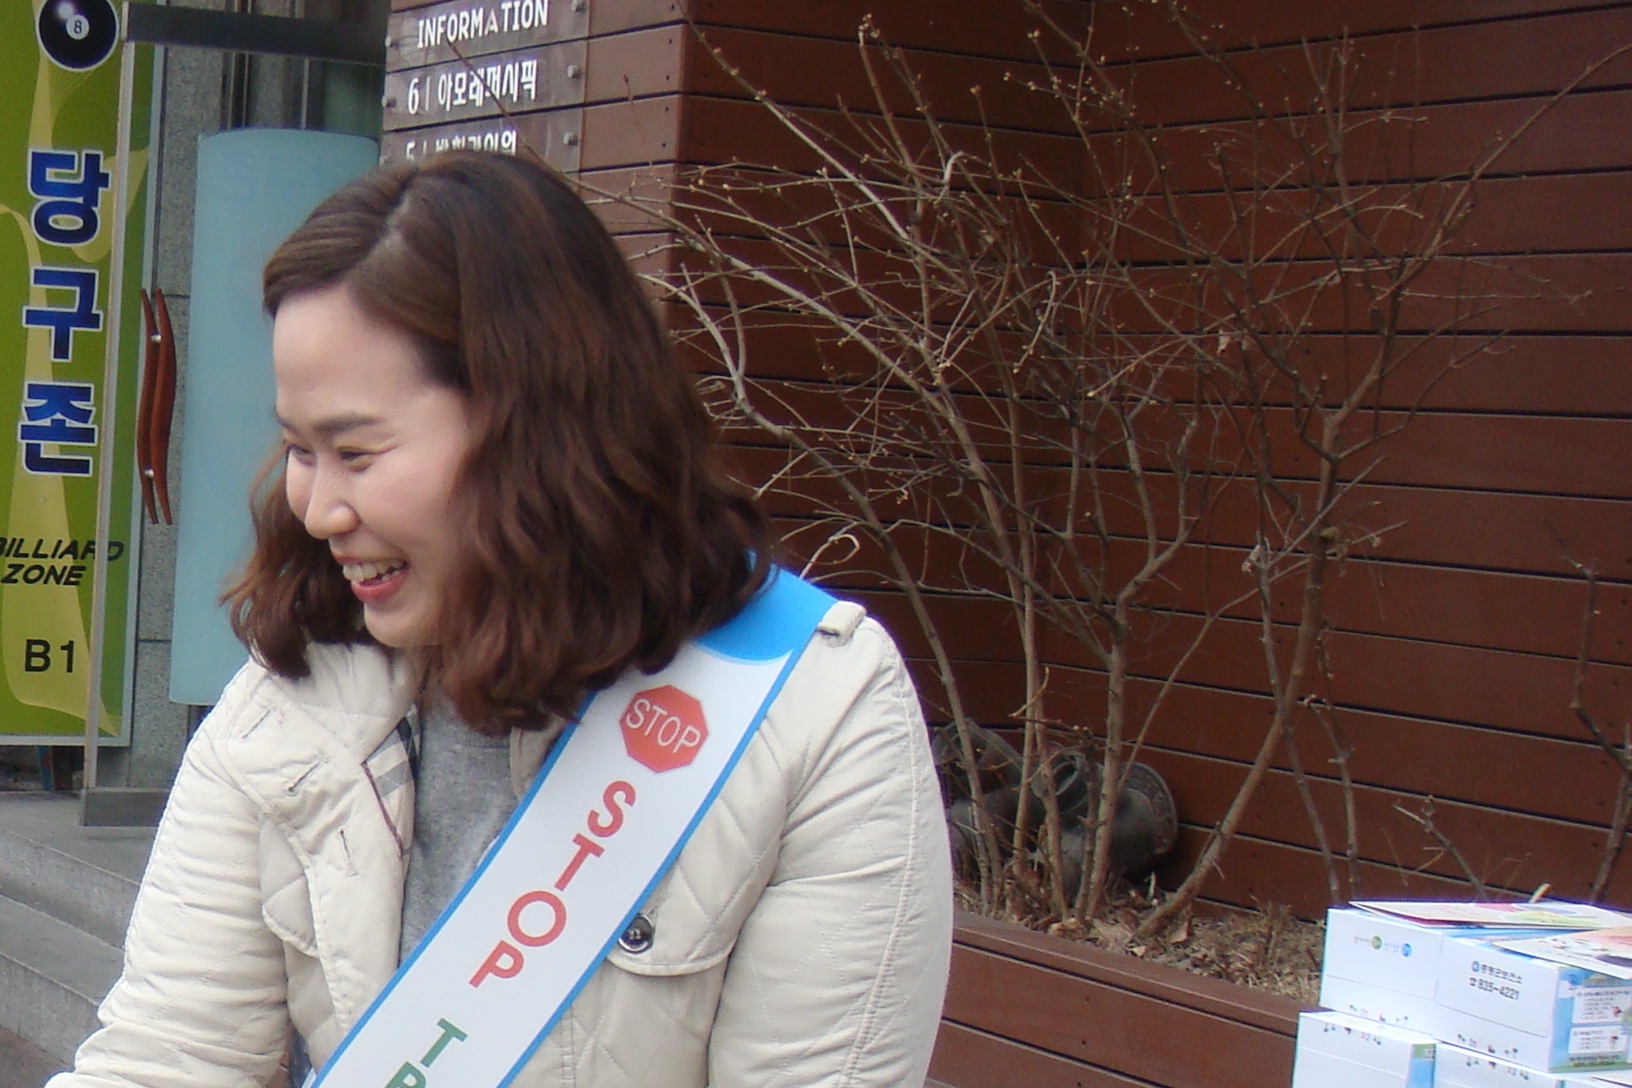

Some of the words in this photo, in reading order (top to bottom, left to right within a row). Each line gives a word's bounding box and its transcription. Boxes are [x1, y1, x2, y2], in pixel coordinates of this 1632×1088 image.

[73, 19, 82, 34] 8
[417, 0, 549, 49] INFORMATION
[408, 78, 420, 115] 6
[18, 149, 113, 477] 당구존
[1, 563, 87, 586] ZONE
[625, 698, 702, 754] STOP
[468, 780, 637, 988] STOP
